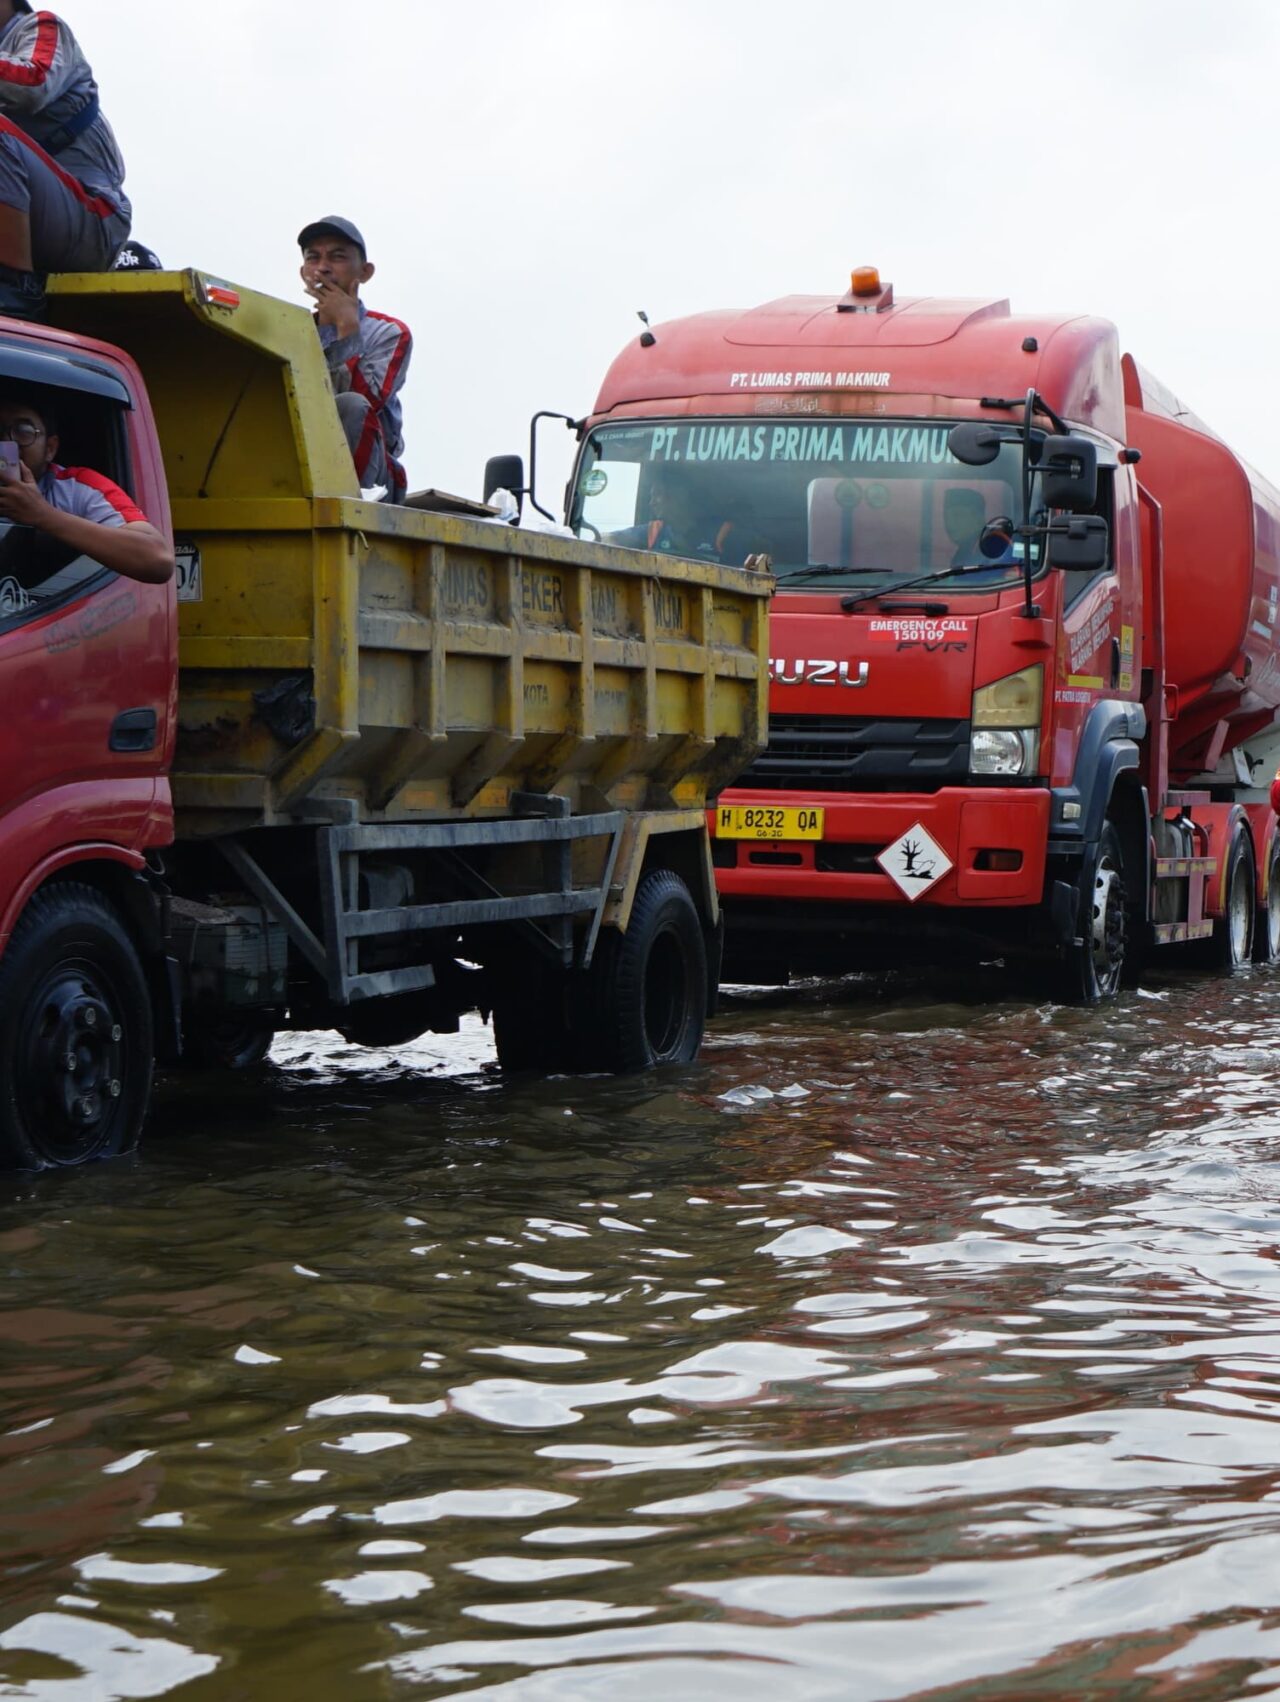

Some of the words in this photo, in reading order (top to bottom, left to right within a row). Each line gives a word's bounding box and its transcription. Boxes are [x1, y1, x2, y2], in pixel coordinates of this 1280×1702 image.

[730, 373, 748, 387] PT.
[750, 373, 792, 387] LUMAS
[794, 372, 832, 386] PRIMA
[835, 372, 891, 387] MAKMUR
[649, 426, 680, 461] PT.
[686, 426, 766, 462] LUMAS
[769, 426, 844, 462] PRIMA
[870, 620, 938, 632] EMERGENCY
[941, 620, 968, 632] CALL
[892, 630, 945, 641] 150109
[896, 642, 968, 653] FVR
[721, 809, 732, 828] H
[744, 809, 785, 829] 8232
